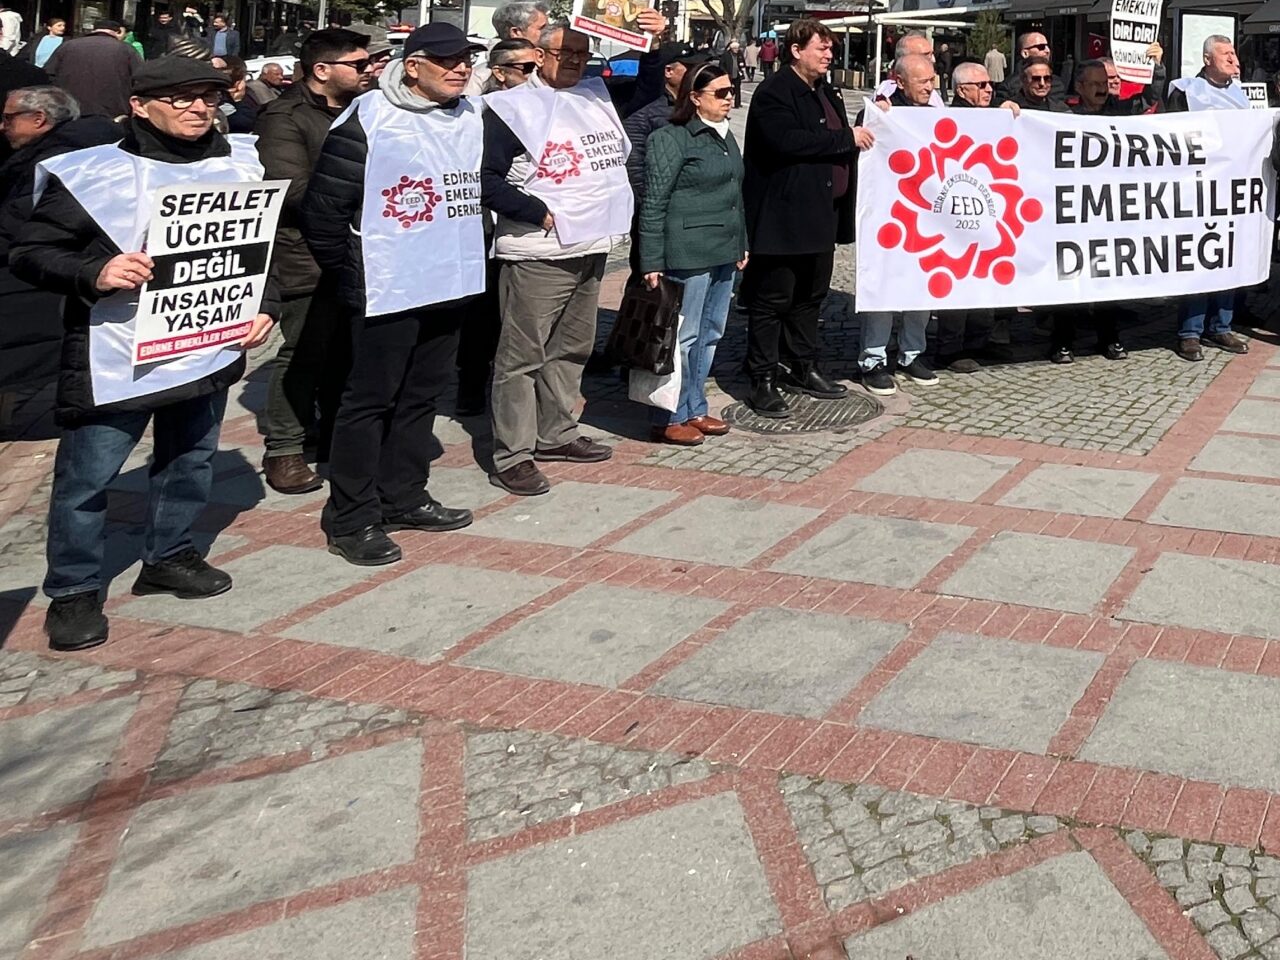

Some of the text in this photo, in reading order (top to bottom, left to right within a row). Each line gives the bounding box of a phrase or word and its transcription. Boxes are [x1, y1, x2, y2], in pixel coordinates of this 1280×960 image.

[1114, 22, 1155, 42] DİRİ DİRİ
[580, 130, 618, 146] EDİRNE
[1054, 125, 1207, 169] EDİRNE
[159, 188, 281, 218] SEFALET
[951, 195, 984, 216] EED
[1055, 171, 1264, 225] EMEKLİLER
[166, 211, 264, 249] ÜCRETİ
[955, 219, 980, 230] 2025
[1056, 221, 1235, 281] DERNEĞİ
[172, 250, 246, 284] DEĞİL
[151, 282, 254, 315] İNSANCA
[164, 303, 243, 333] YAŞAM
[140, 342, 173, 357] EDİRNE
[174, 332, 221, 350] EMEKLİLER
